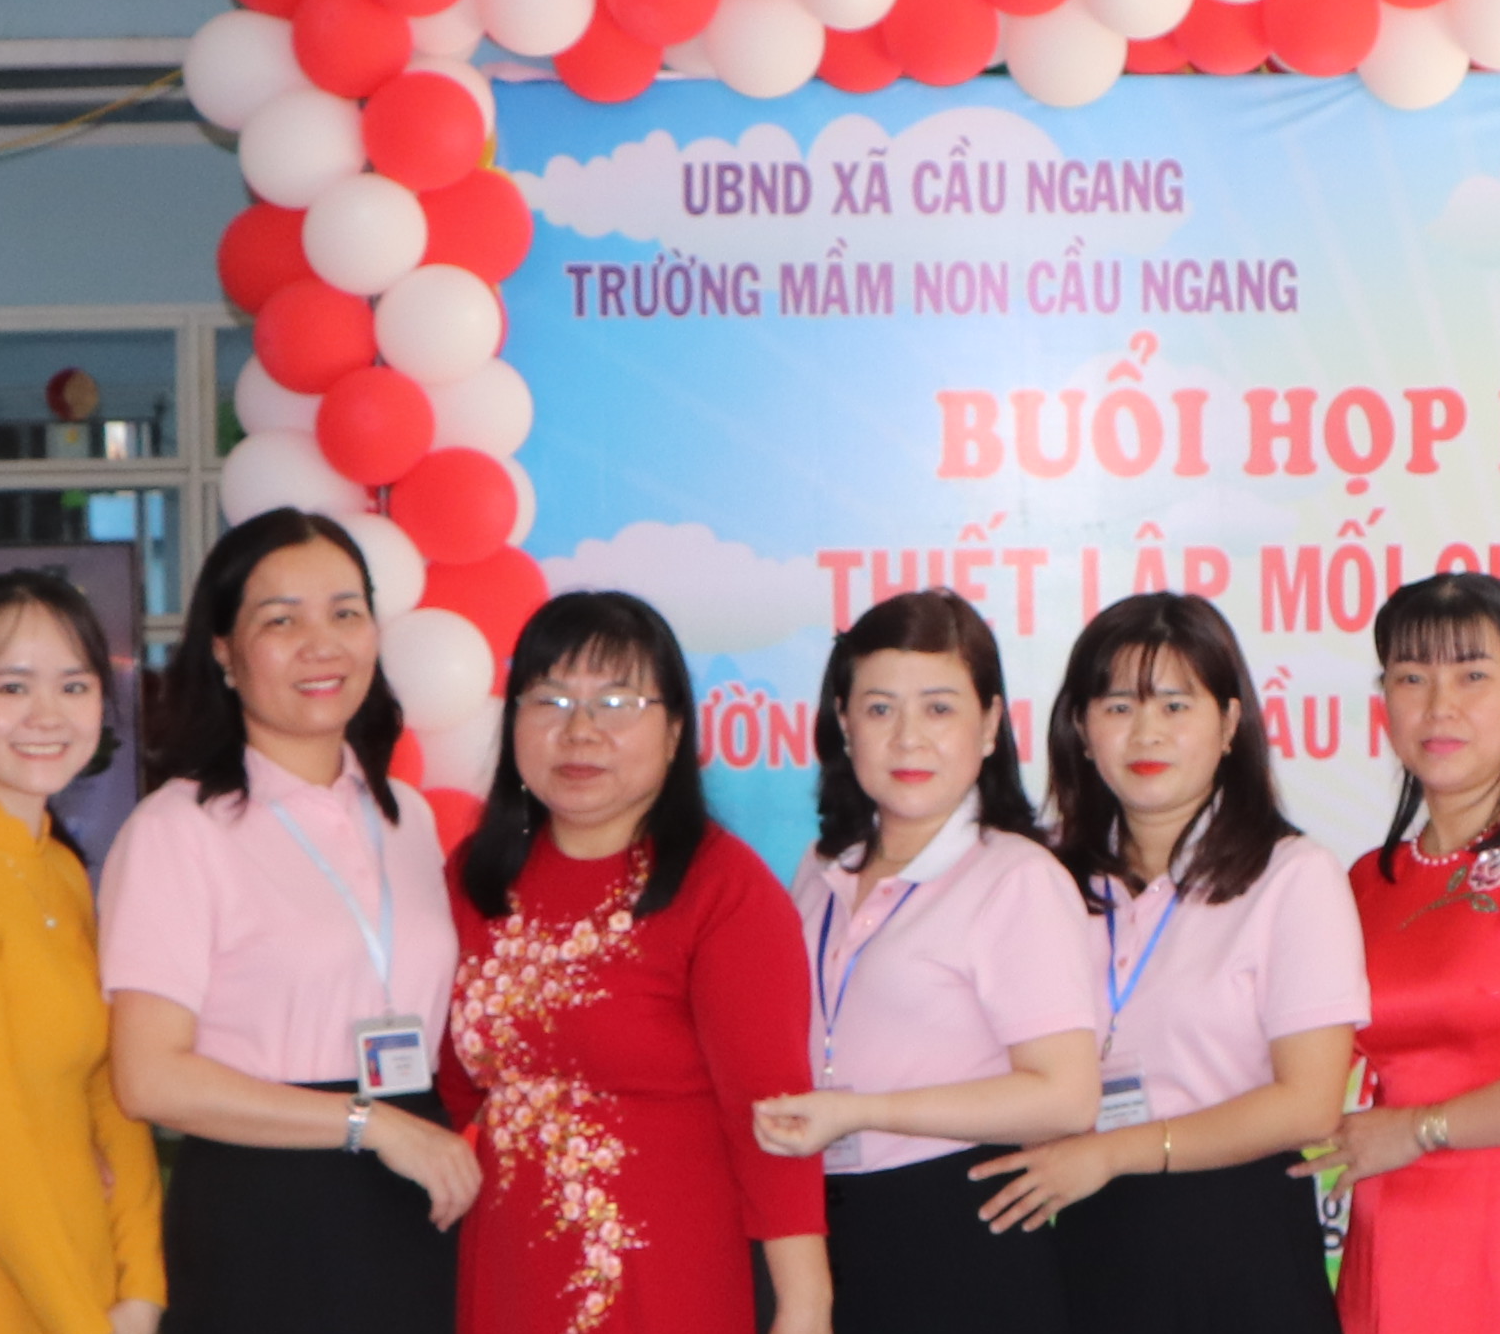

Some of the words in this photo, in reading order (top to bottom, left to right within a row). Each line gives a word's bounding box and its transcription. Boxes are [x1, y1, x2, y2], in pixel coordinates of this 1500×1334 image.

[682, 163, 812, 216] UBND
[831, 146, 892, 215] XÃ
[912, 135, 1007, 215] CẦU
[1027, 159, 1185, 214] NGANG
[565, 247, 762, 317] TRƯỜNG
[779, 237, 894, 316] MẦM
[913, 260, 1009, 316] NON
[1026, 235, 1122, 315] CẦU
[1141, 258, 1299, 314] NGANG
[935, 330, 1211, 479] BUỔI
[1242, 386, 1468, 496] HỌP
